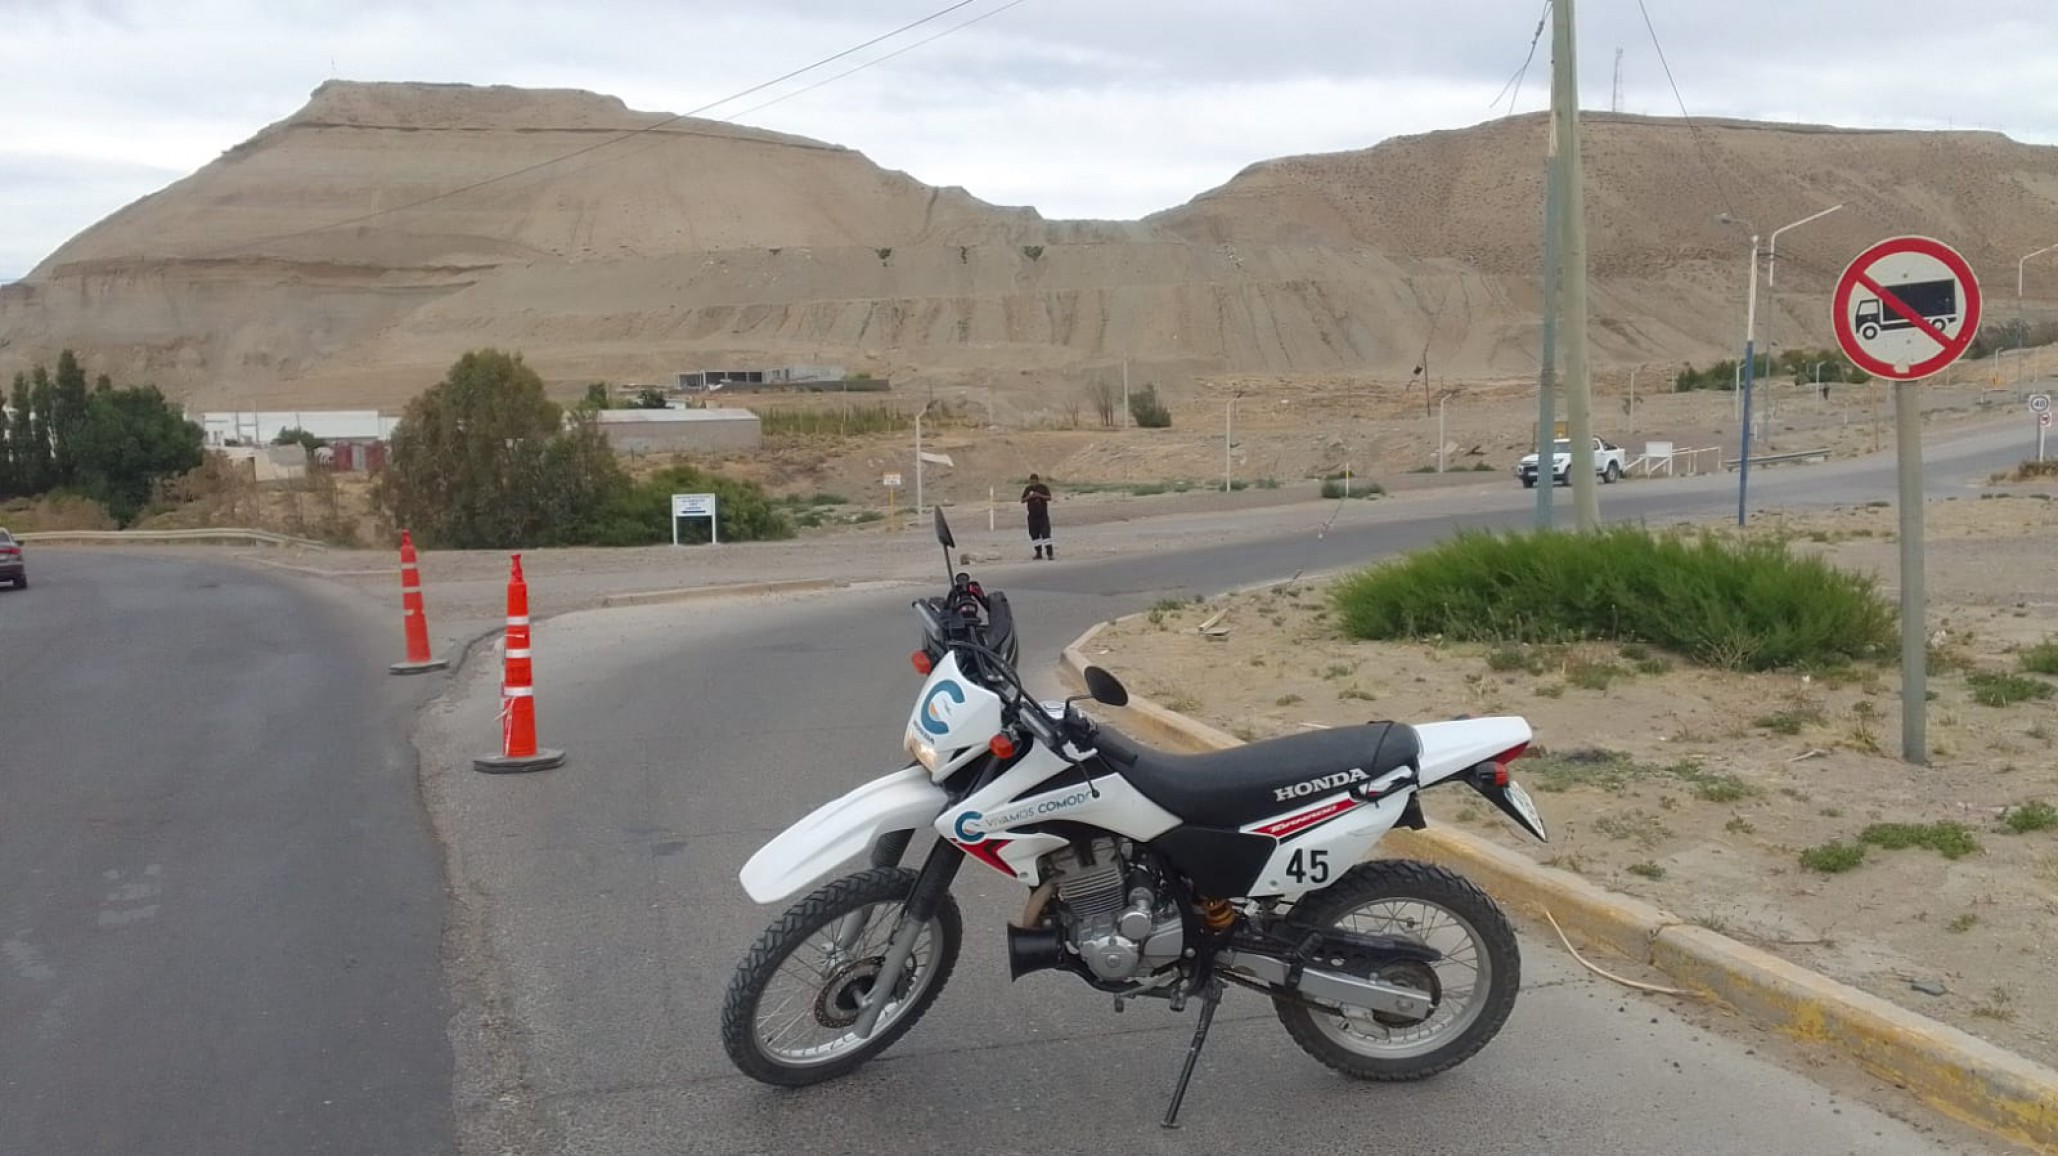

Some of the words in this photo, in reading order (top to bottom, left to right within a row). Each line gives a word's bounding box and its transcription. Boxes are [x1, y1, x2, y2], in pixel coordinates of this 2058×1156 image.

[1274, 768, 1370, 802] HONDA
[986, 808, 1035, 827] VIVAMOS
[1285, 848, 1329, 884] 45
